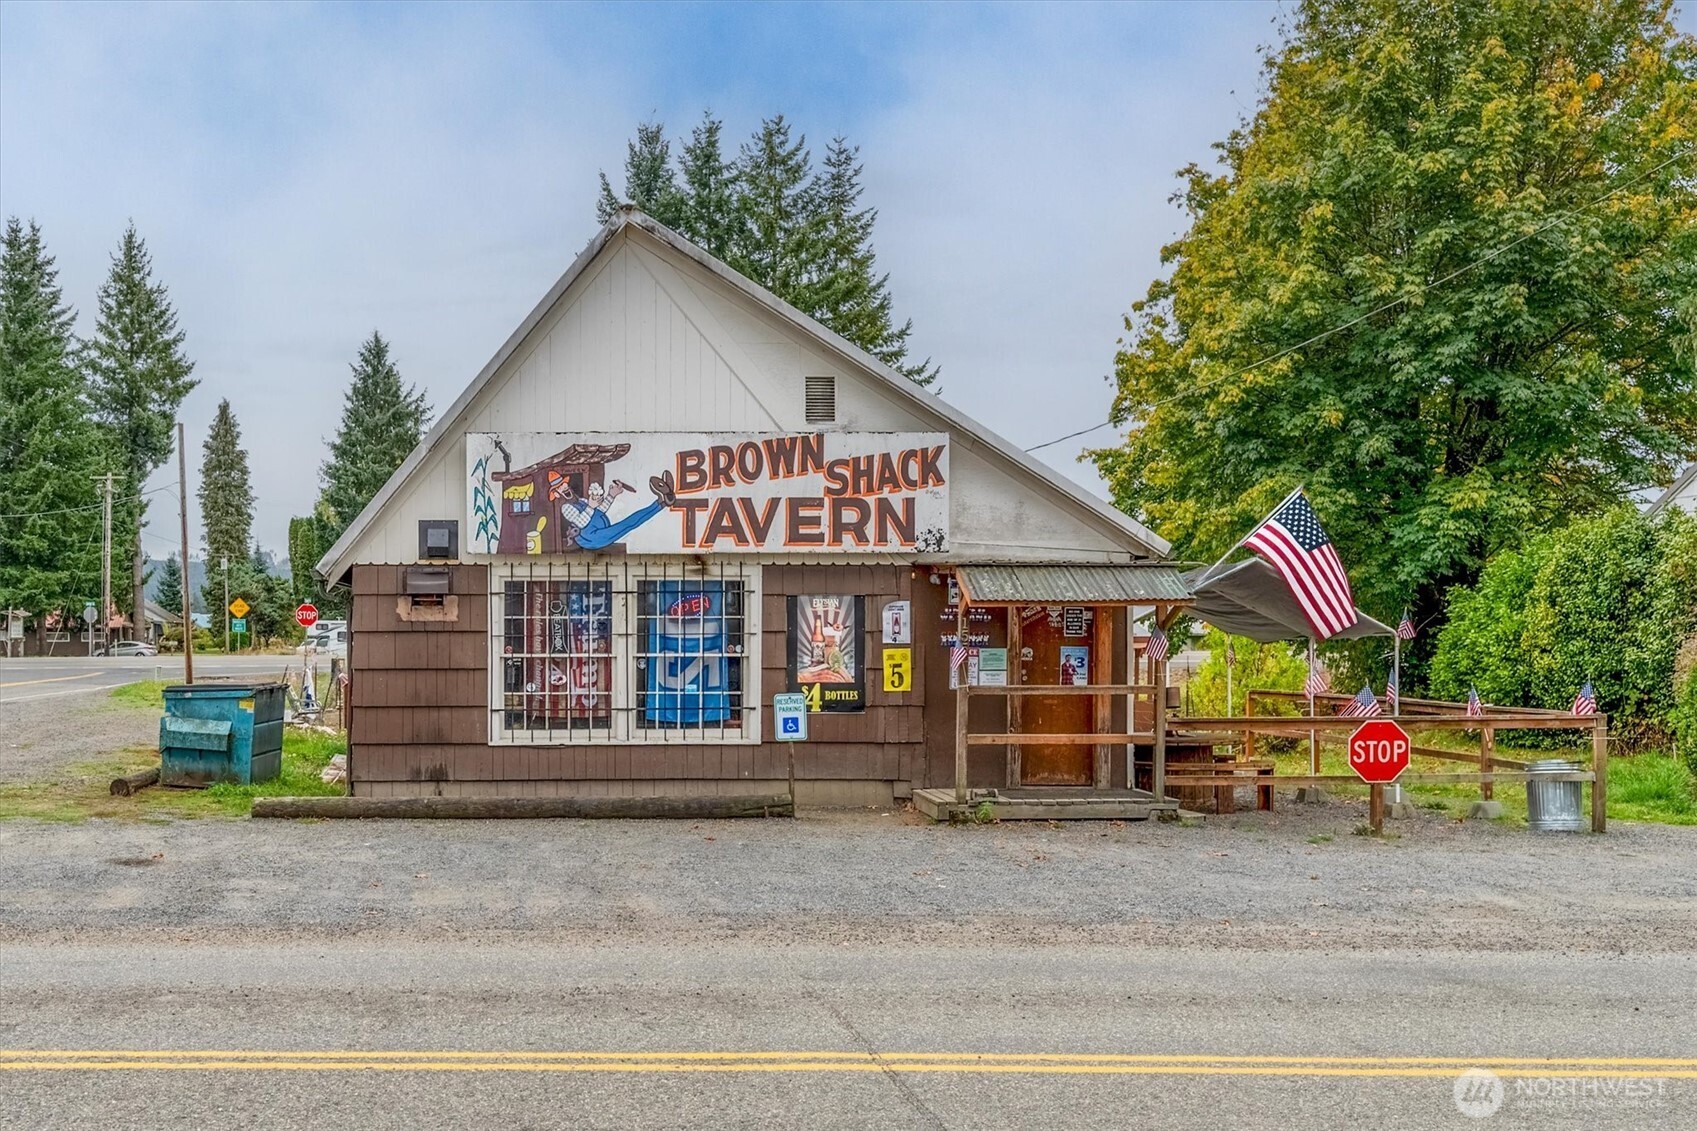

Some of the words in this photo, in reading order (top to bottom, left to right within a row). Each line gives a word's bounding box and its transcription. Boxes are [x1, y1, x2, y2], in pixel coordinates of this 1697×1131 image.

[676, 433, 825, 494] BROWN
[822, 444, 947, 498] SHACK
[671, 496, 918, 548] TAVERN
[297, 611, 317, 620] STOP
[670, 597, 710, 618] OPEN
[572, 587, 606, 707] Trump
[776, 697, 803, 705] RESERVED
[801, 682, 822, 712] $4
[824, 690, 858, 700] BOTTLES
[1352, 740, 1406, 764] STOP
